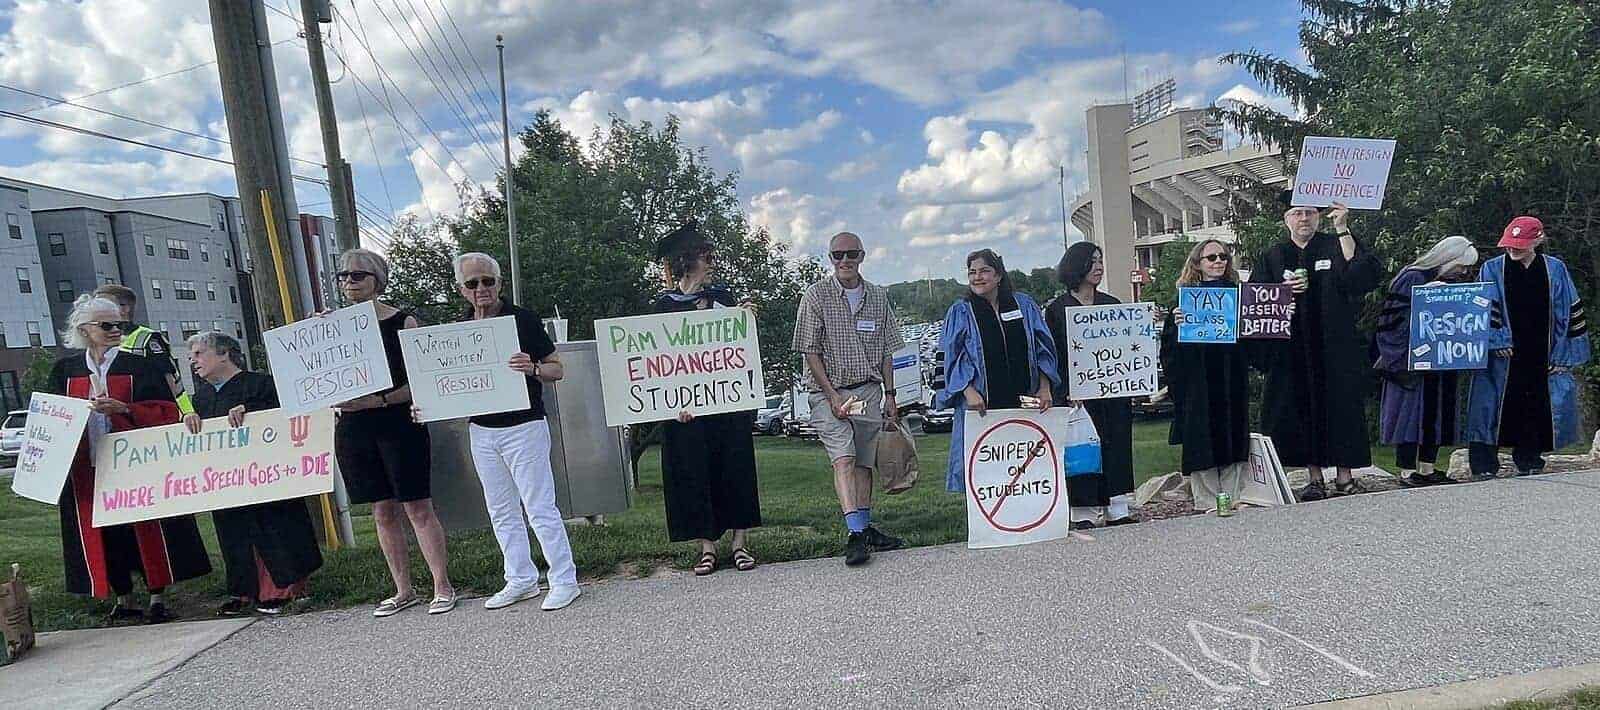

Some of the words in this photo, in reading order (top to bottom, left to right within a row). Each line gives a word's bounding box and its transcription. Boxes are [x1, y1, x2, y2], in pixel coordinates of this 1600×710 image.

[1304, 144, 1350, 160] WHITTEN
[1353, 147, 1392, 161] RESIGN
[1334, 162, 1356, 177] NO
[1190, 290, 1226, 312] YAY
[1251, 286, 1280, 303] YOU
[1073, 307, 1144, 325] CONGRATS
[1184, 313, 1225, 325] CLASS
[1241, 318, 1291, 336] BETTER
[278, 319, 342, 353] WRITTEN
[350, 313, 369, 333] TO
[415, 334, 460, 355] WRITTEN
[468, 331, 483, 345] TO
[609, 325, 658, 353] PAM
[662, 311, 748, 347] WHITTEN
[1082, 327, 1118, 340] CLASS
[299, 339, 364, 372] WHITTEN
[1092, 347, 1123, 369] YOU
[1437, 340, 1485, 365] NOW
[627, 347, 746, 382] ENDANGERS
[1077, 355, 1151, 386] DESERVED
[300, 363, 369, 402] RESIGN
[1099, 373, 1155, 397] BETTER!
[113, 437, 158, 470] PAM
[165, 426, 250, 459] WHITTEN
[978, 441, 1047, 463] SNIPERS
[102, 487, 155, 511] WHERE
[164, 472, 199, 499] FREE
[202, 465, 245, 494] SPEECH
[248, 462, 280, 487] GOES
[301, 452, 330, 477] DIE
[1007, 465, 1026, 477] ON
[977, 479, 1052, 501] STUDENTS
